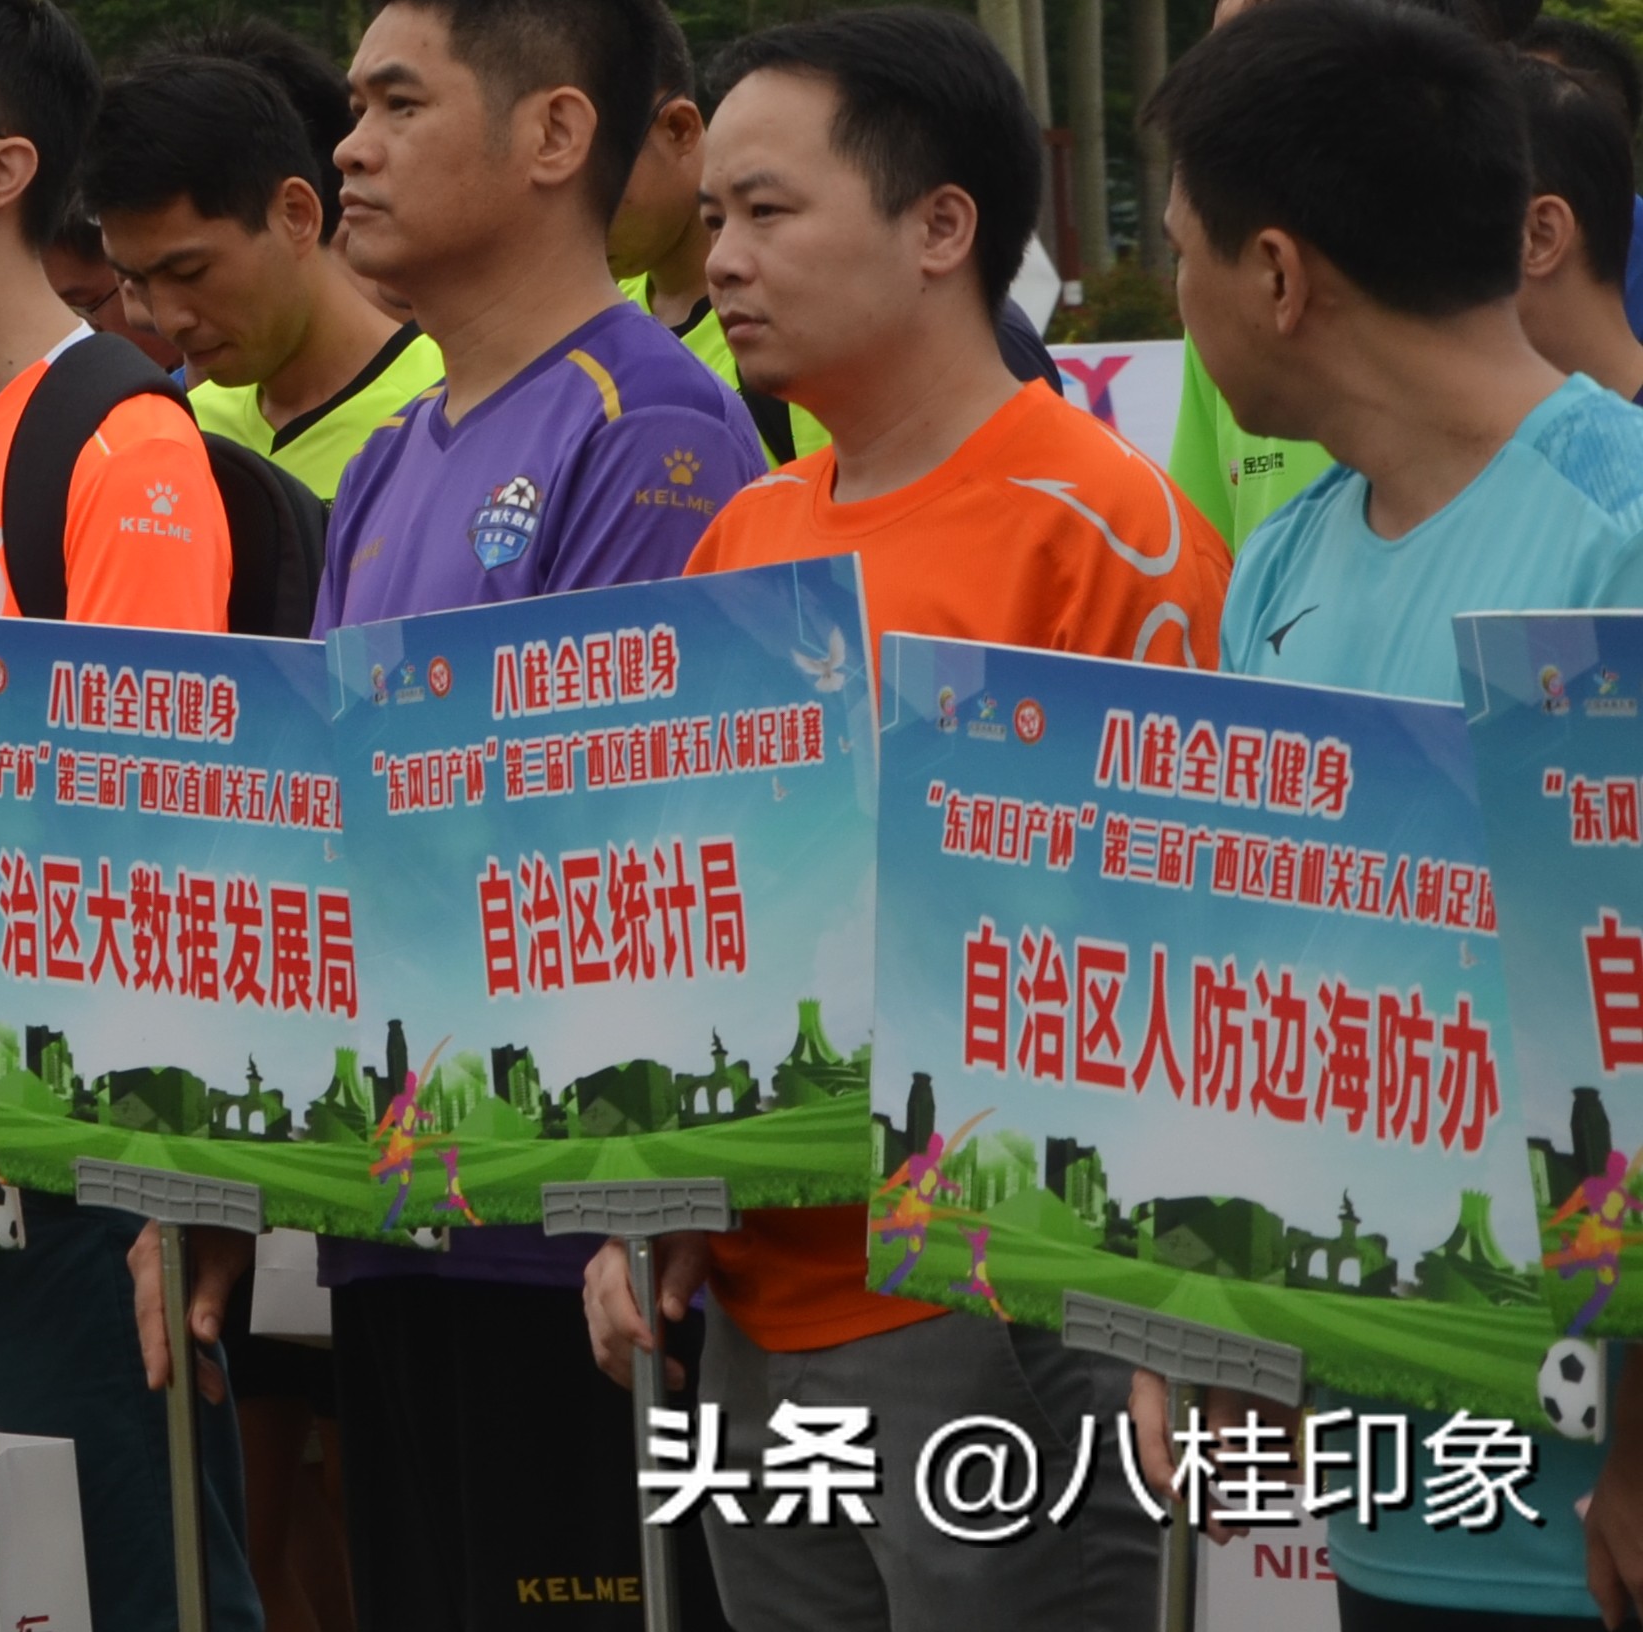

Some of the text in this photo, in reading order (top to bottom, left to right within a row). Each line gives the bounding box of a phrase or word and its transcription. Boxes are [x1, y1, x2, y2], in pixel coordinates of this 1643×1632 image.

[119, 516, 194, 544] KELME
[634, 488, 718, 516] KELME
[47, 660, 239, 744] 八桂全民健身
[492, 623, 681, 719] 八桂全民健身
[1095, 708, 1353, 818] 八桂全民健身
[1543, 770, 1643, 844] “东风
[477, 834, 748, 999] 自治区统计局
[963, 915, 1501, 1155] 自治区人防边海防办
[517, 1576, 641, 1604] KELME
